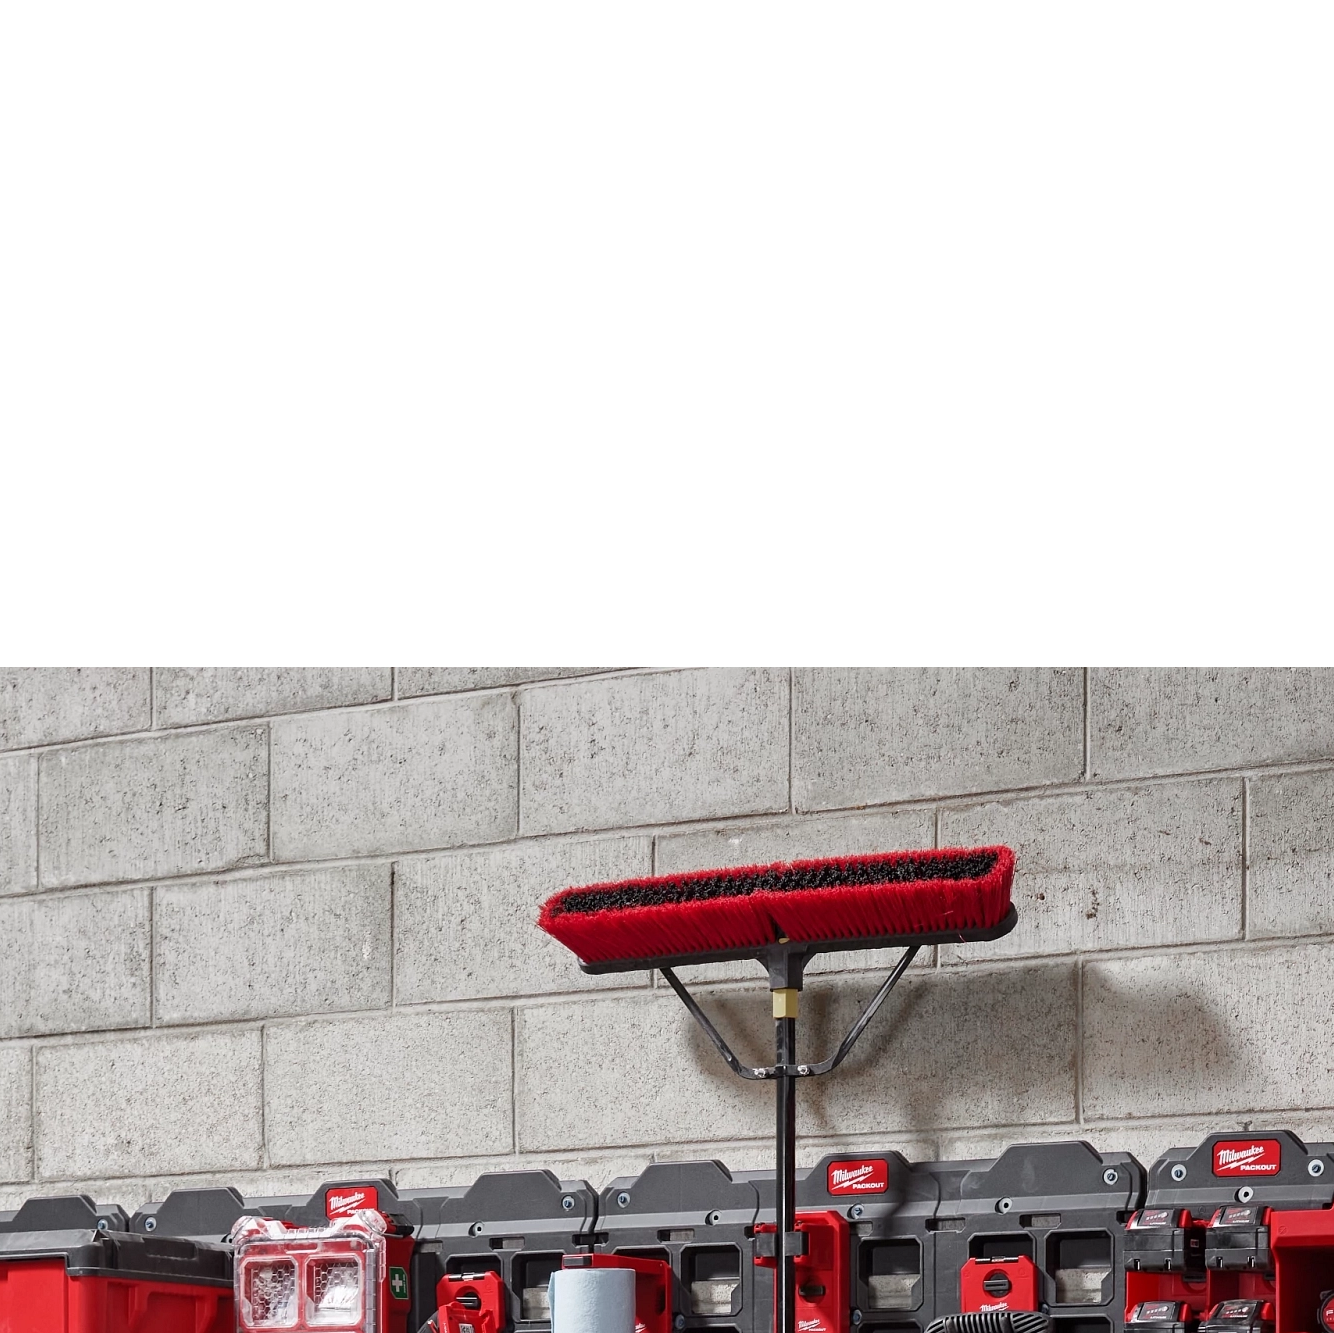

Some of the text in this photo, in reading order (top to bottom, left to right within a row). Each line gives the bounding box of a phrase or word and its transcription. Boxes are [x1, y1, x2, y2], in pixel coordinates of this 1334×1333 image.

[1217, 1144, 1264, 1165] Milwaukee
[830, 1164, 875, 1185] Milwaukee
[852, 1182, 884, 1190] PACKOUT
[328, 1192, 364, 1210] Milwaukee
[797, 1317, 821, 1331] Milwaukee
